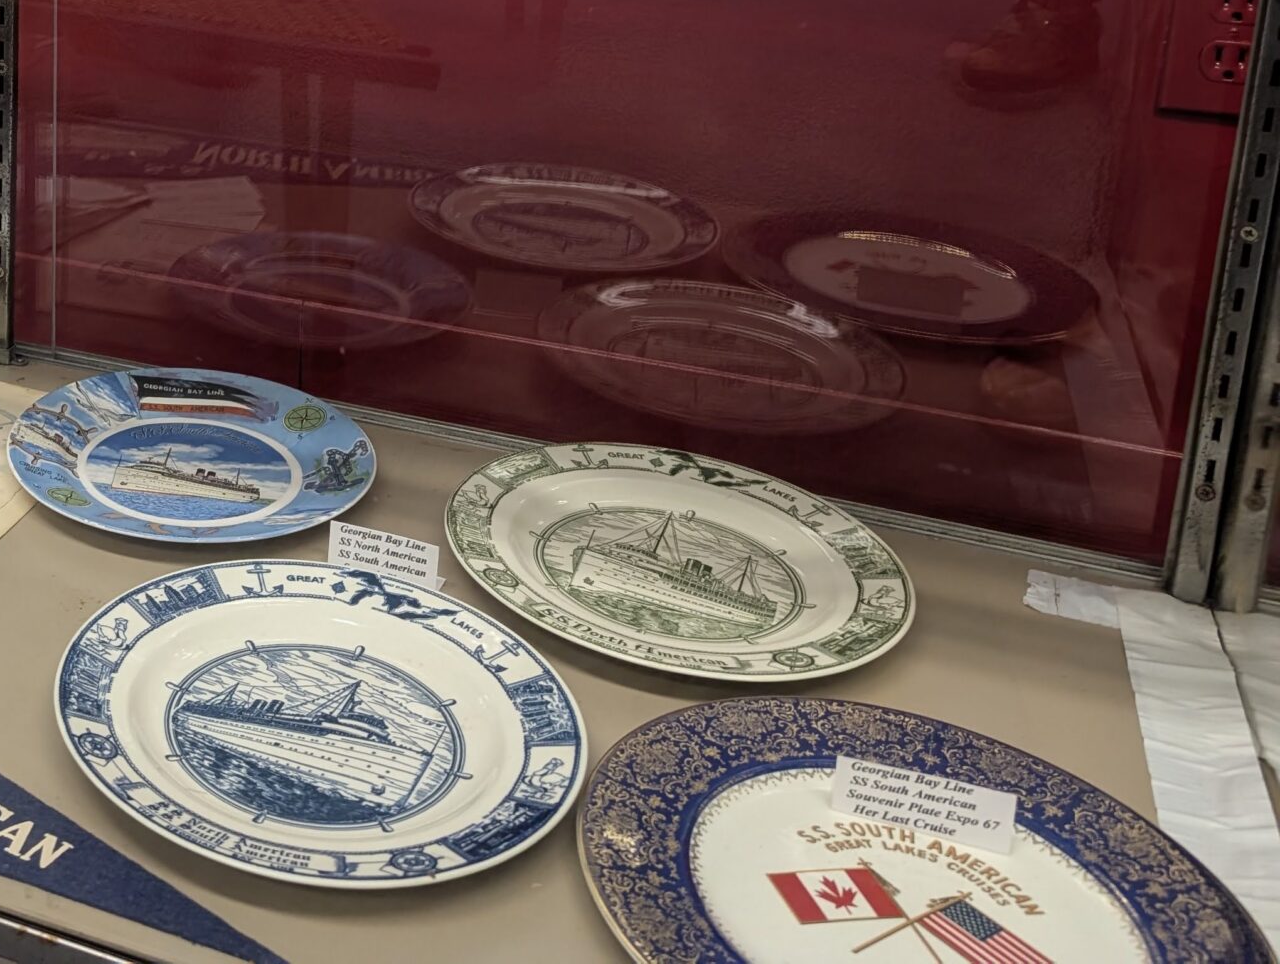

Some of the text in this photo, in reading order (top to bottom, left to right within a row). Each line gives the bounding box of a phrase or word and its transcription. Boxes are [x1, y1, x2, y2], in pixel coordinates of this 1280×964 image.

[143, 382, 226, 397] GEORGIAN BAY LINE
[188, 404, 226, 414] AMERICAN
[607, 450, 799, 503] GREAT LAKES
[338, 536, 428, 566] SS North American
[340, 524, 427, 552] Georgian Bay Line
[337, 549, 351, 559] SS
[352, 552, 379, 567] South
[381, 559, 427, 578] American
[286, 573, 326, 585] GREAT
[450, 617, 485, 640] LAKES
[571, 620, 629, 648] North
[633, 642, 730, 667] American
[849, 775, 978, 812] SS South American
[851, 761, 976, 796] Georgian Bay Line
[845, 788, 1001, 832] Souvenir Plate Expo 67
[853, 803, 958, 837] Her Last Cruise
[186, 817, 231, 842] North
[234, 836, 312, 863] American
[231, 843, 310, 869] American
[797, 821, 1047, 918] S.S. SOUTH AMERICAN
[825, 838, 1013, 909] GREAT LAKES CRUISES
